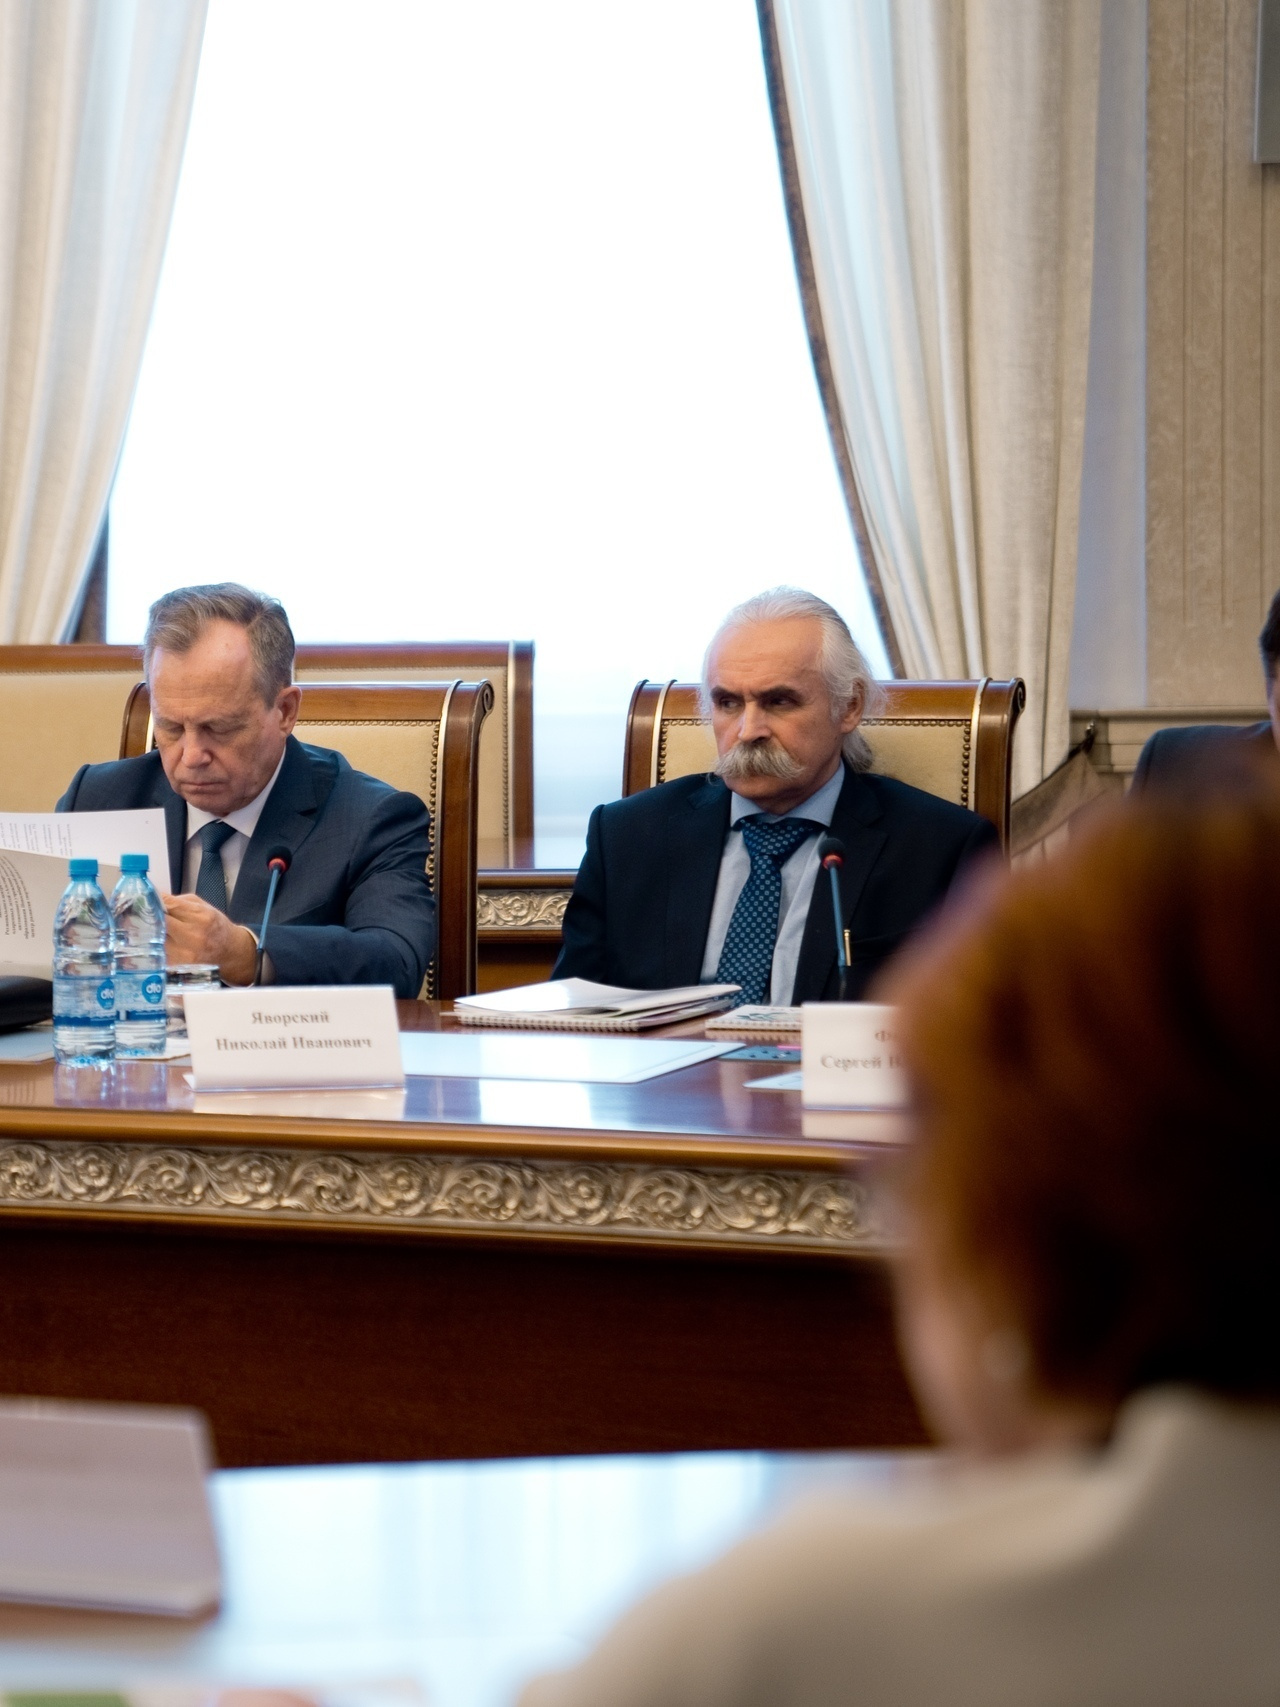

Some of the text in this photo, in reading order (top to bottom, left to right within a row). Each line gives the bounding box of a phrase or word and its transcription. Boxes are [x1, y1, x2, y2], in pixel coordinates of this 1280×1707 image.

[251, 1011, 330, 1027] Яворский
[215, 1036, 372, 1051] Николай Иванович
[820, 1054, 882, 1072] Сергей
